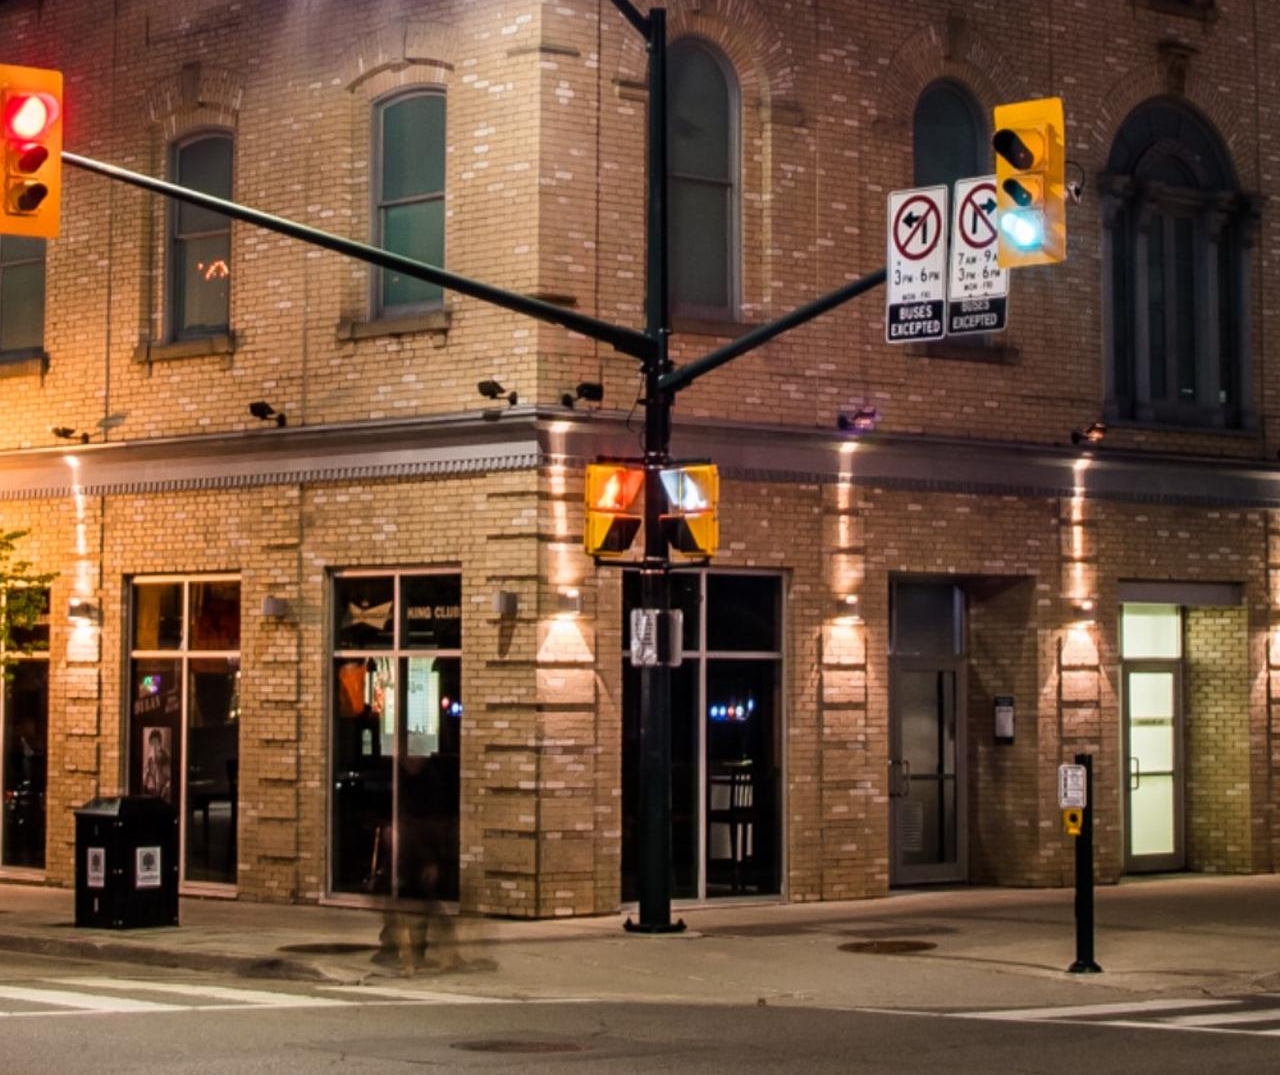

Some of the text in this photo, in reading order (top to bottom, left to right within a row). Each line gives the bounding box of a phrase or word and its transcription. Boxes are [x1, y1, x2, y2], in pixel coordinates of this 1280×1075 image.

[899, 304, 933, 320] BUSES
[961, 299, 991, 313] BUSES
[890, 319, 941, 337] EXCEPTED
[952, 312, 998, 330] EXCEPTED
